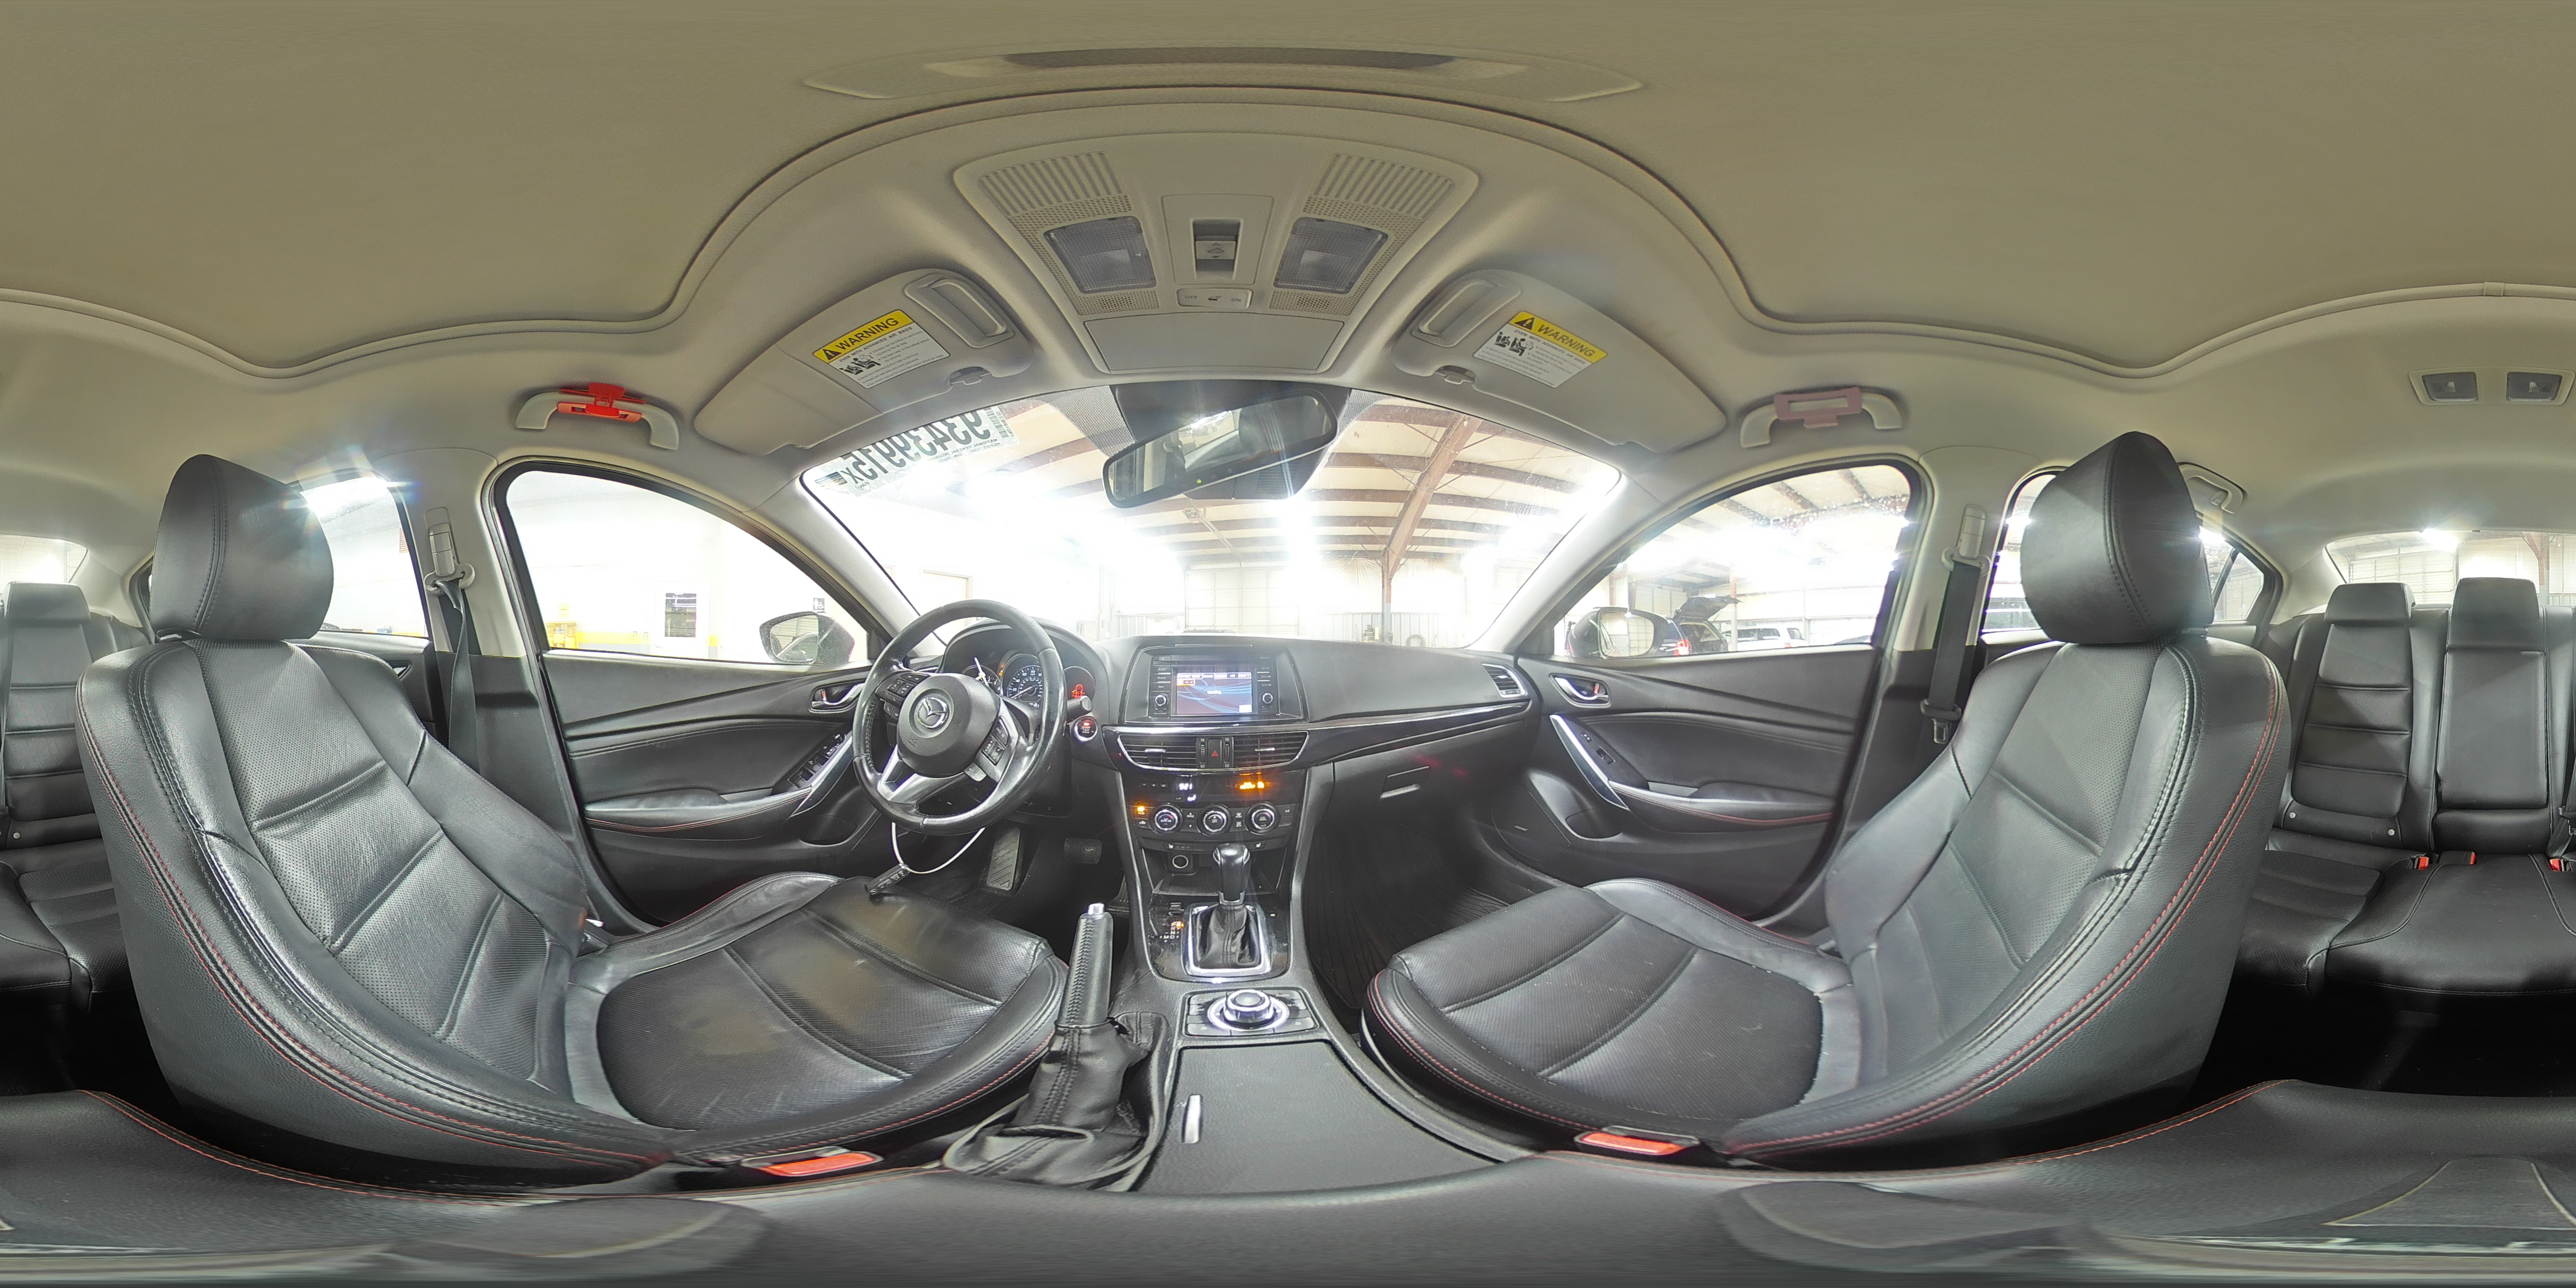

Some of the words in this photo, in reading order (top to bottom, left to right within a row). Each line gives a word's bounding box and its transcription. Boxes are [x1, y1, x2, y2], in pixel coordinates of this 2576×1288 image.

[835, 318, 899, 350] WARNING
[862, 337, 888, 350] ADVANCED
[897, 326, 913, 334] BAGS
[1537, 323, 1596, 357] WARNING
